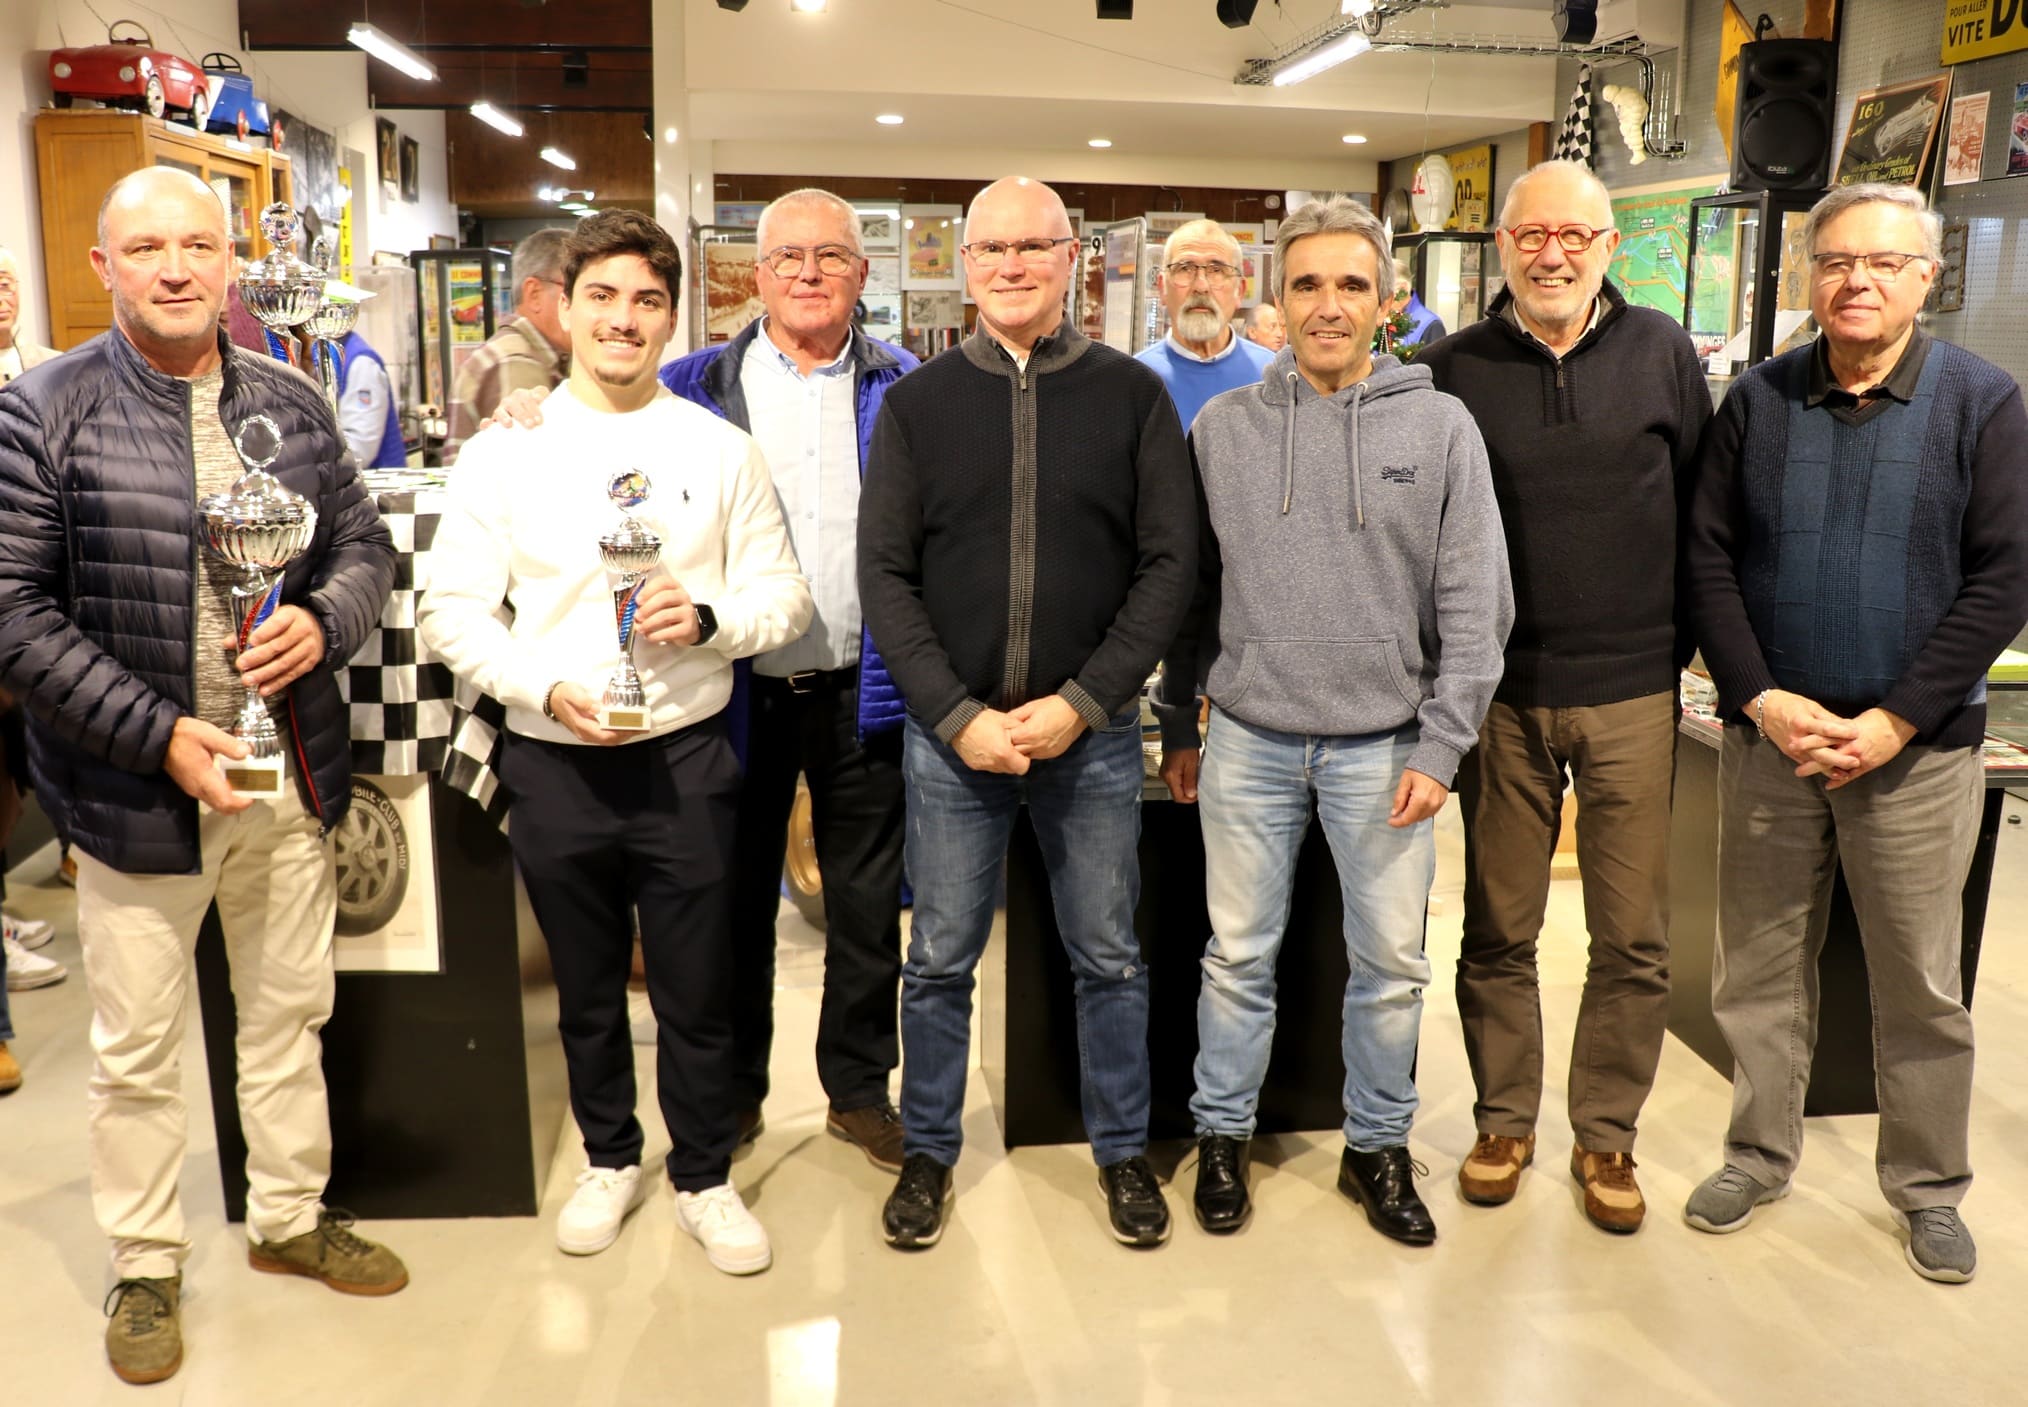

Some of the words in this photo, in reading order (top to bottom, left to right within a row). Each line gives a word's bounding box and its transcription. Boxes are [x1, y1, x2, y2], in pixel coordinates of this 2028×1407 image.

[1950, 5, 1967, 18] POUR
[1949, 19, 1984, 47] VITE
[1859, 101, 1884, 120] 160
[1888, 164, 1916, 179] PETROL
[1092, 237, 1101, 256] 9
